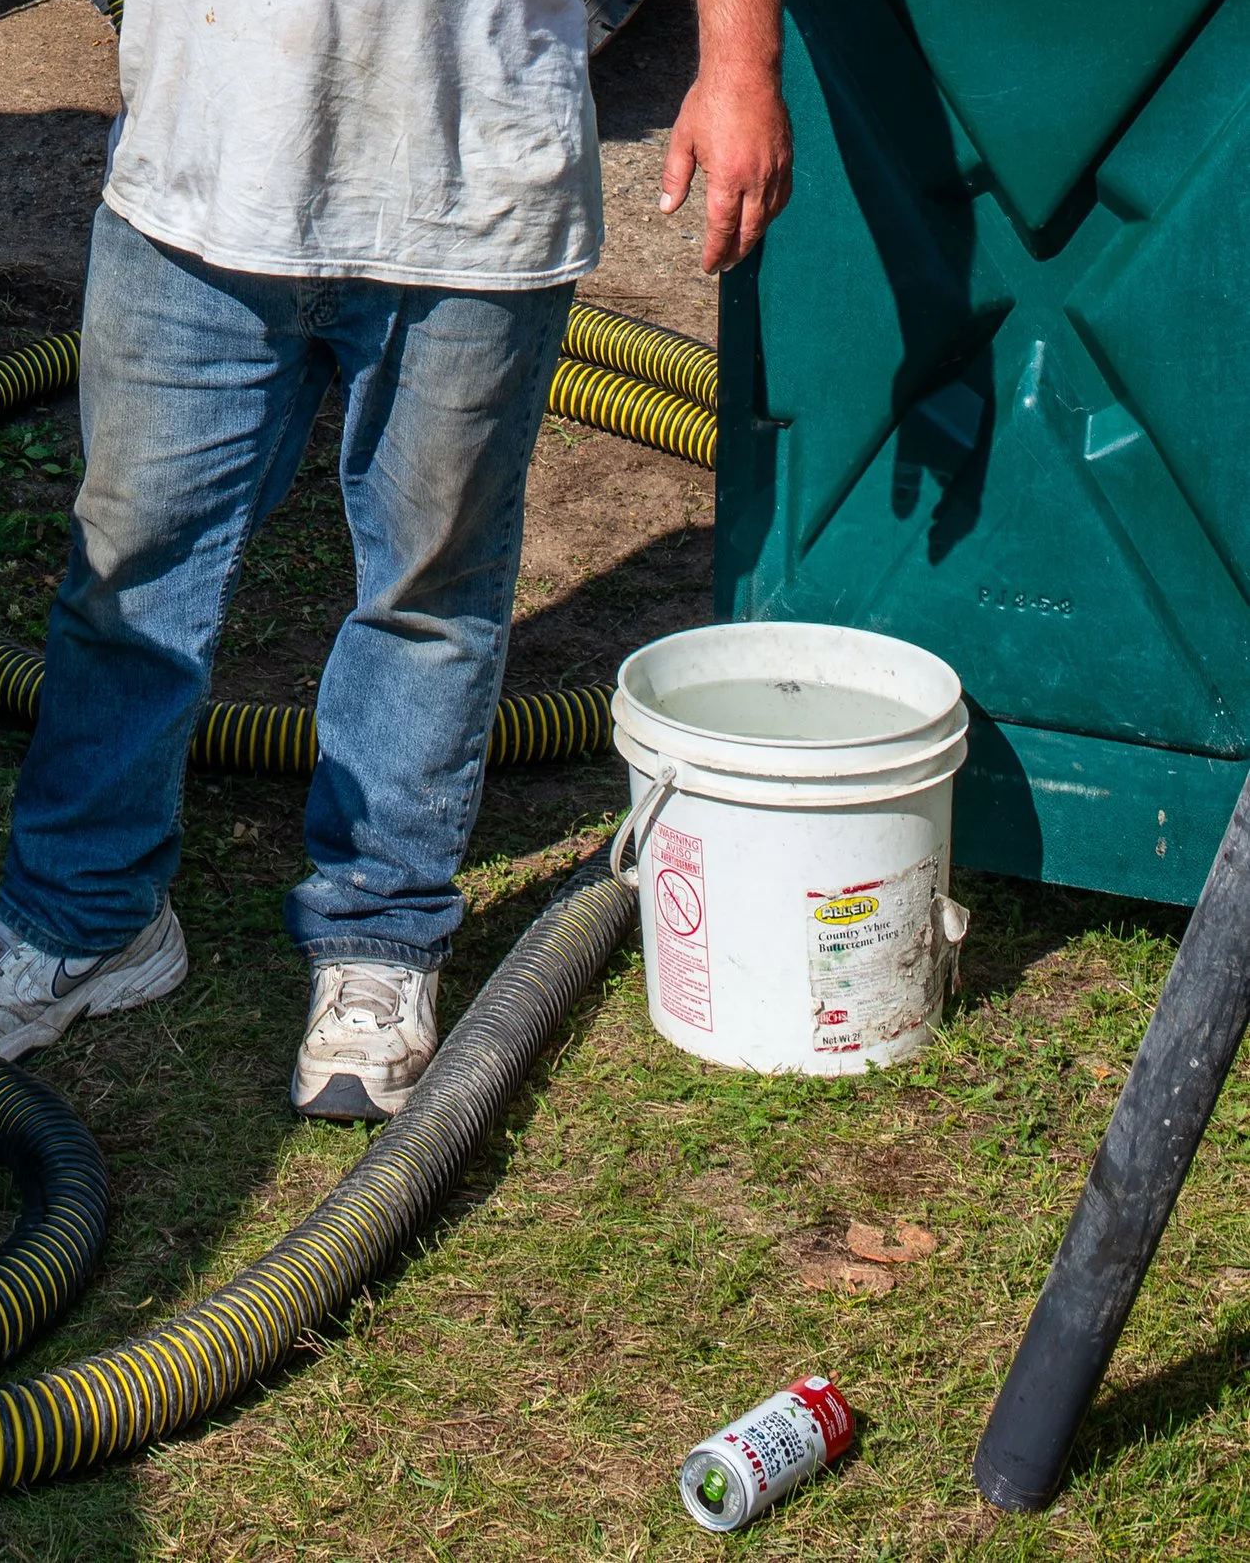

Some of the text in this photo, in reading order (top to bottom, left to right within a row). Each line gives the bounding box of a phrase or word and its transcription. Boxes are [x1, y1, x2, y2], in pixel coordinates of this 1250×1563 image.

[657, 825, 700, 852] WARNING
[665, 842, 692, 860] AVISO
[660, 850, 701, 875] AVERTISSEMENT
[821, 900, 874, 919] ALLEN
[818, 928, 861, 942] Country
